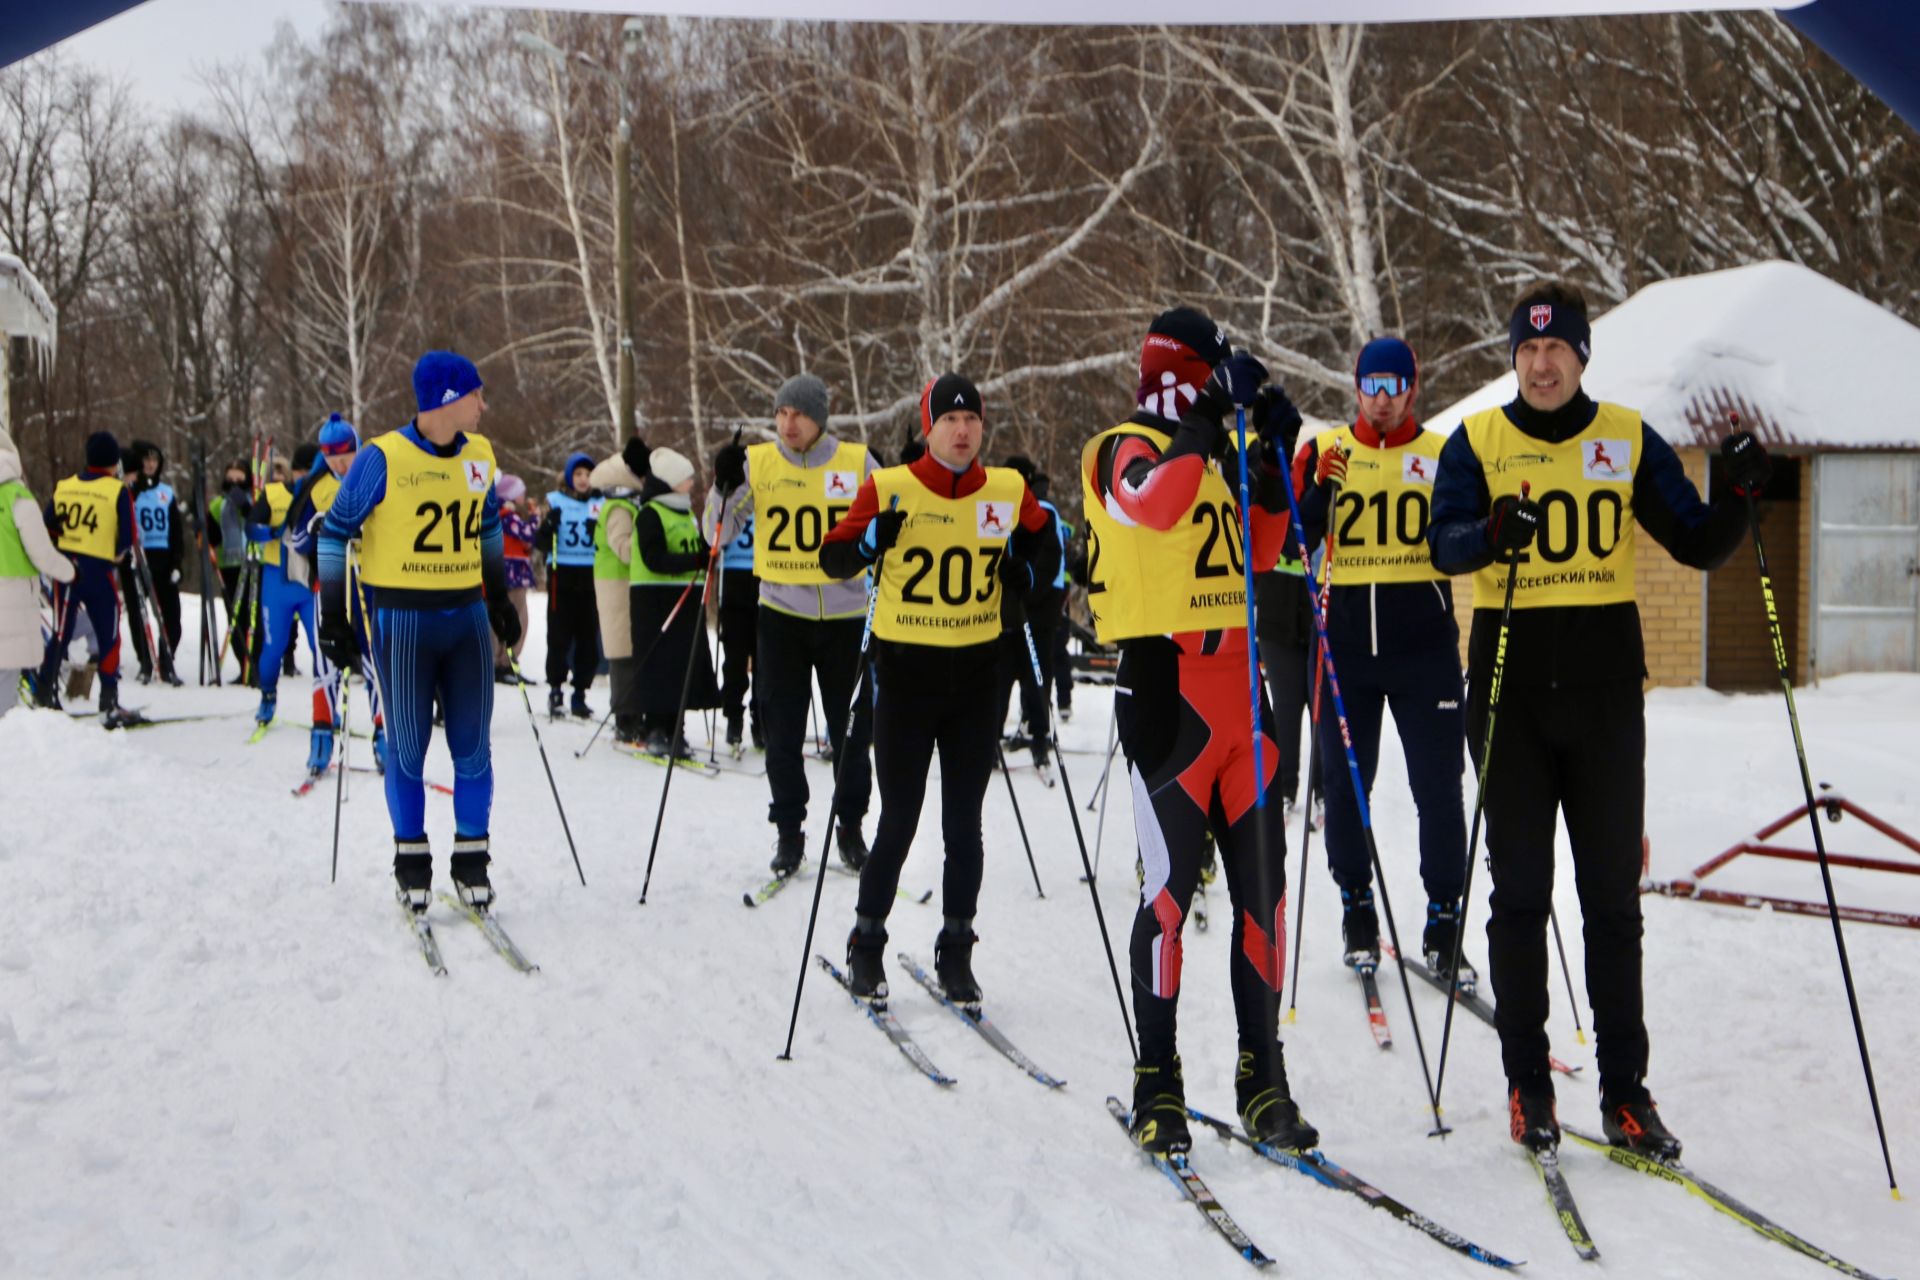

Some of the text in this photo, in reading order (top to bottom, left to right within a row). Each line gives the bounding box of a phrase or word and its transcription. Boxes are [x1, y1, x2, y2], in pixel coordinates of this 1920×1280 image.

[140, 507, 165, 532] 69
[415, 499, 480, 553] 214
[1336, 490, 1429, 547] 210
[901, 545, 1003, 607] 203
[1588, 567, 1615, 583] РАЙОН
[895, 610, 997, 629] АЛЕКСЕЕВСКИЙ РАЙОН
[1760, 576, 1778, 622] LEKI
[1496, 625, 1509, 666] LEKI
[1608, 1148, 1684, 1186] FISCHER
